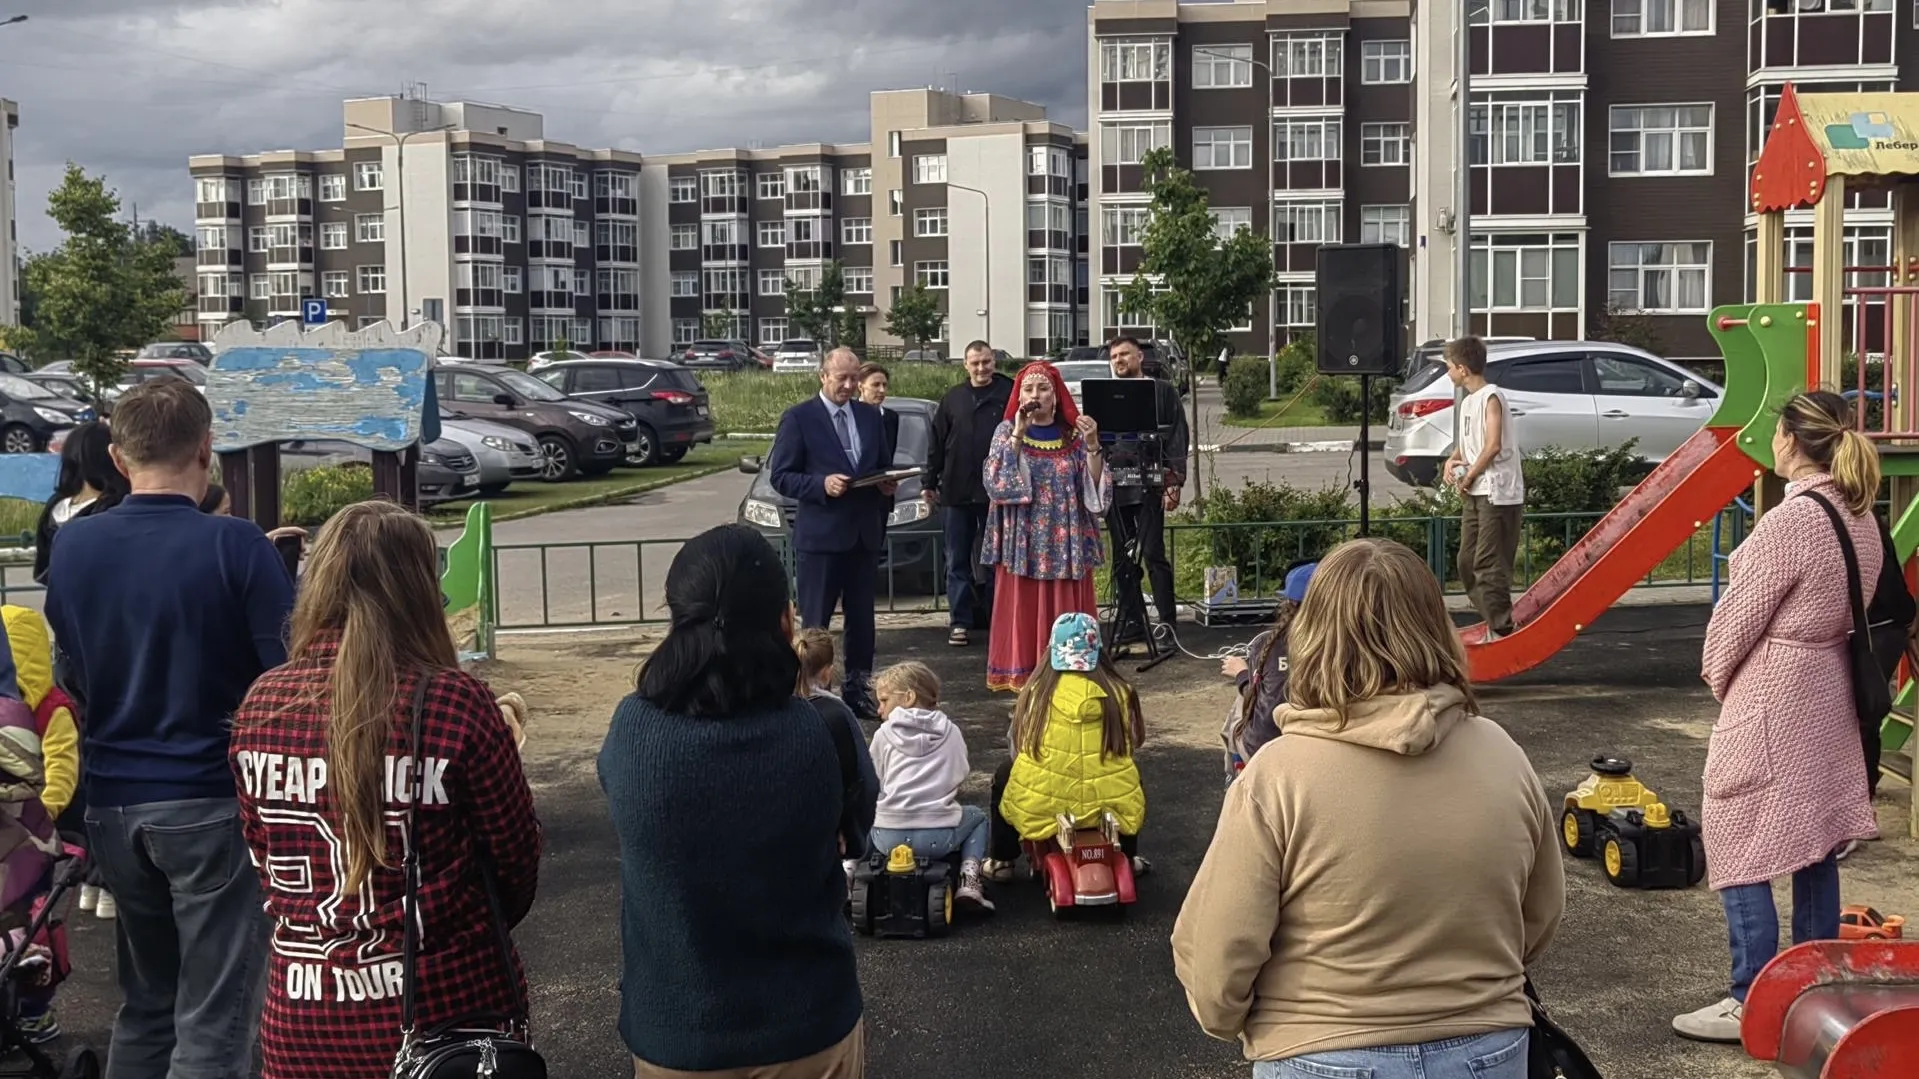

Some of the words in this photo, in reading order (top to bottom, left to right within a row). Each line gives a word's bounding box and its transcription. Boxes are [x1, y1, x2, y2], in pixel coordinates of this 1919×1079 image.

[308, 302, 321, 321] P
[1277, 656, 1289, 672] Б
[1081, 848, 1105, 861] NO.891
[286, 962, 323, 1001] ON
[332, 960, 405, 1002] TOUR
